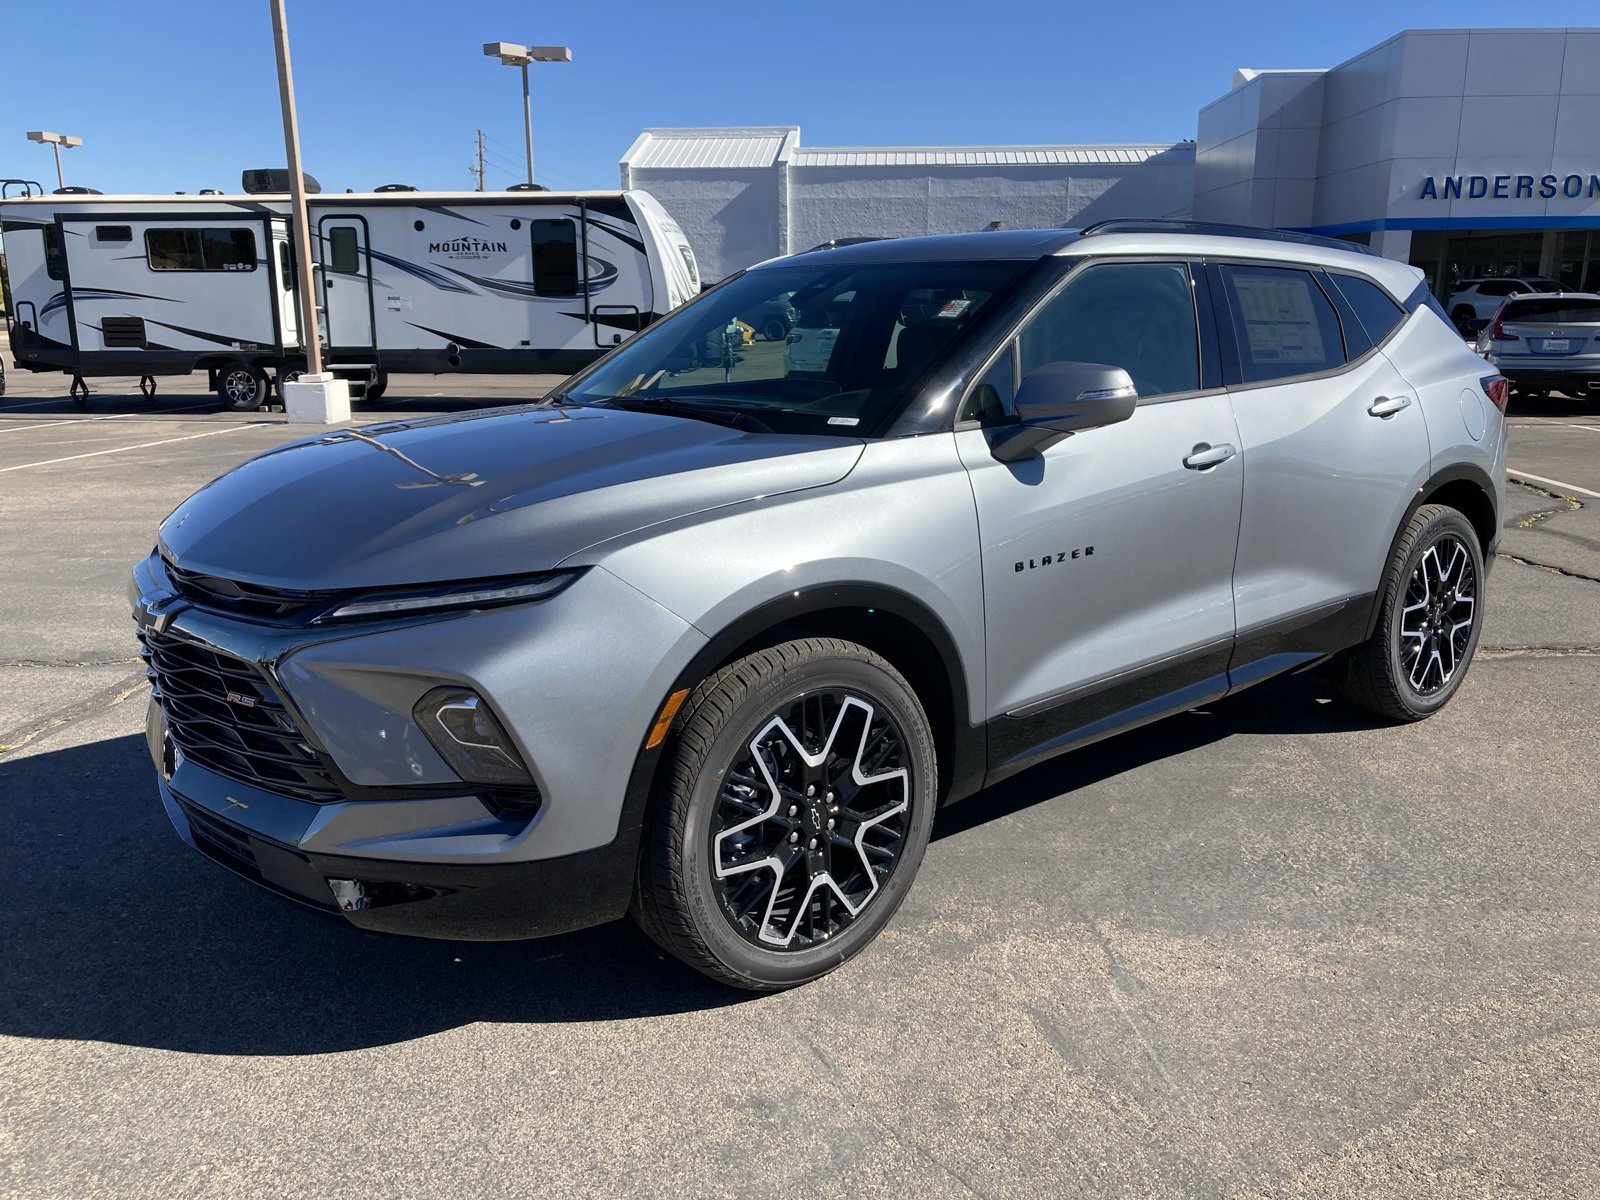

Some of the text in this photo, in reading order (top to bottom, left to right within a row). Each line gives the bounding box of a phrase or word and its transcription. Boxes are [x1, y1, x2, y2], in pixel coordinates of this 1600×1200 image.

[1420, 174, 1600, 200] ANDERSON
[429, 242, 507, 252] MOUNTAIN
[1015, 546, 1095, 572] BLAZER
[227, 692, 256, 707] RS
